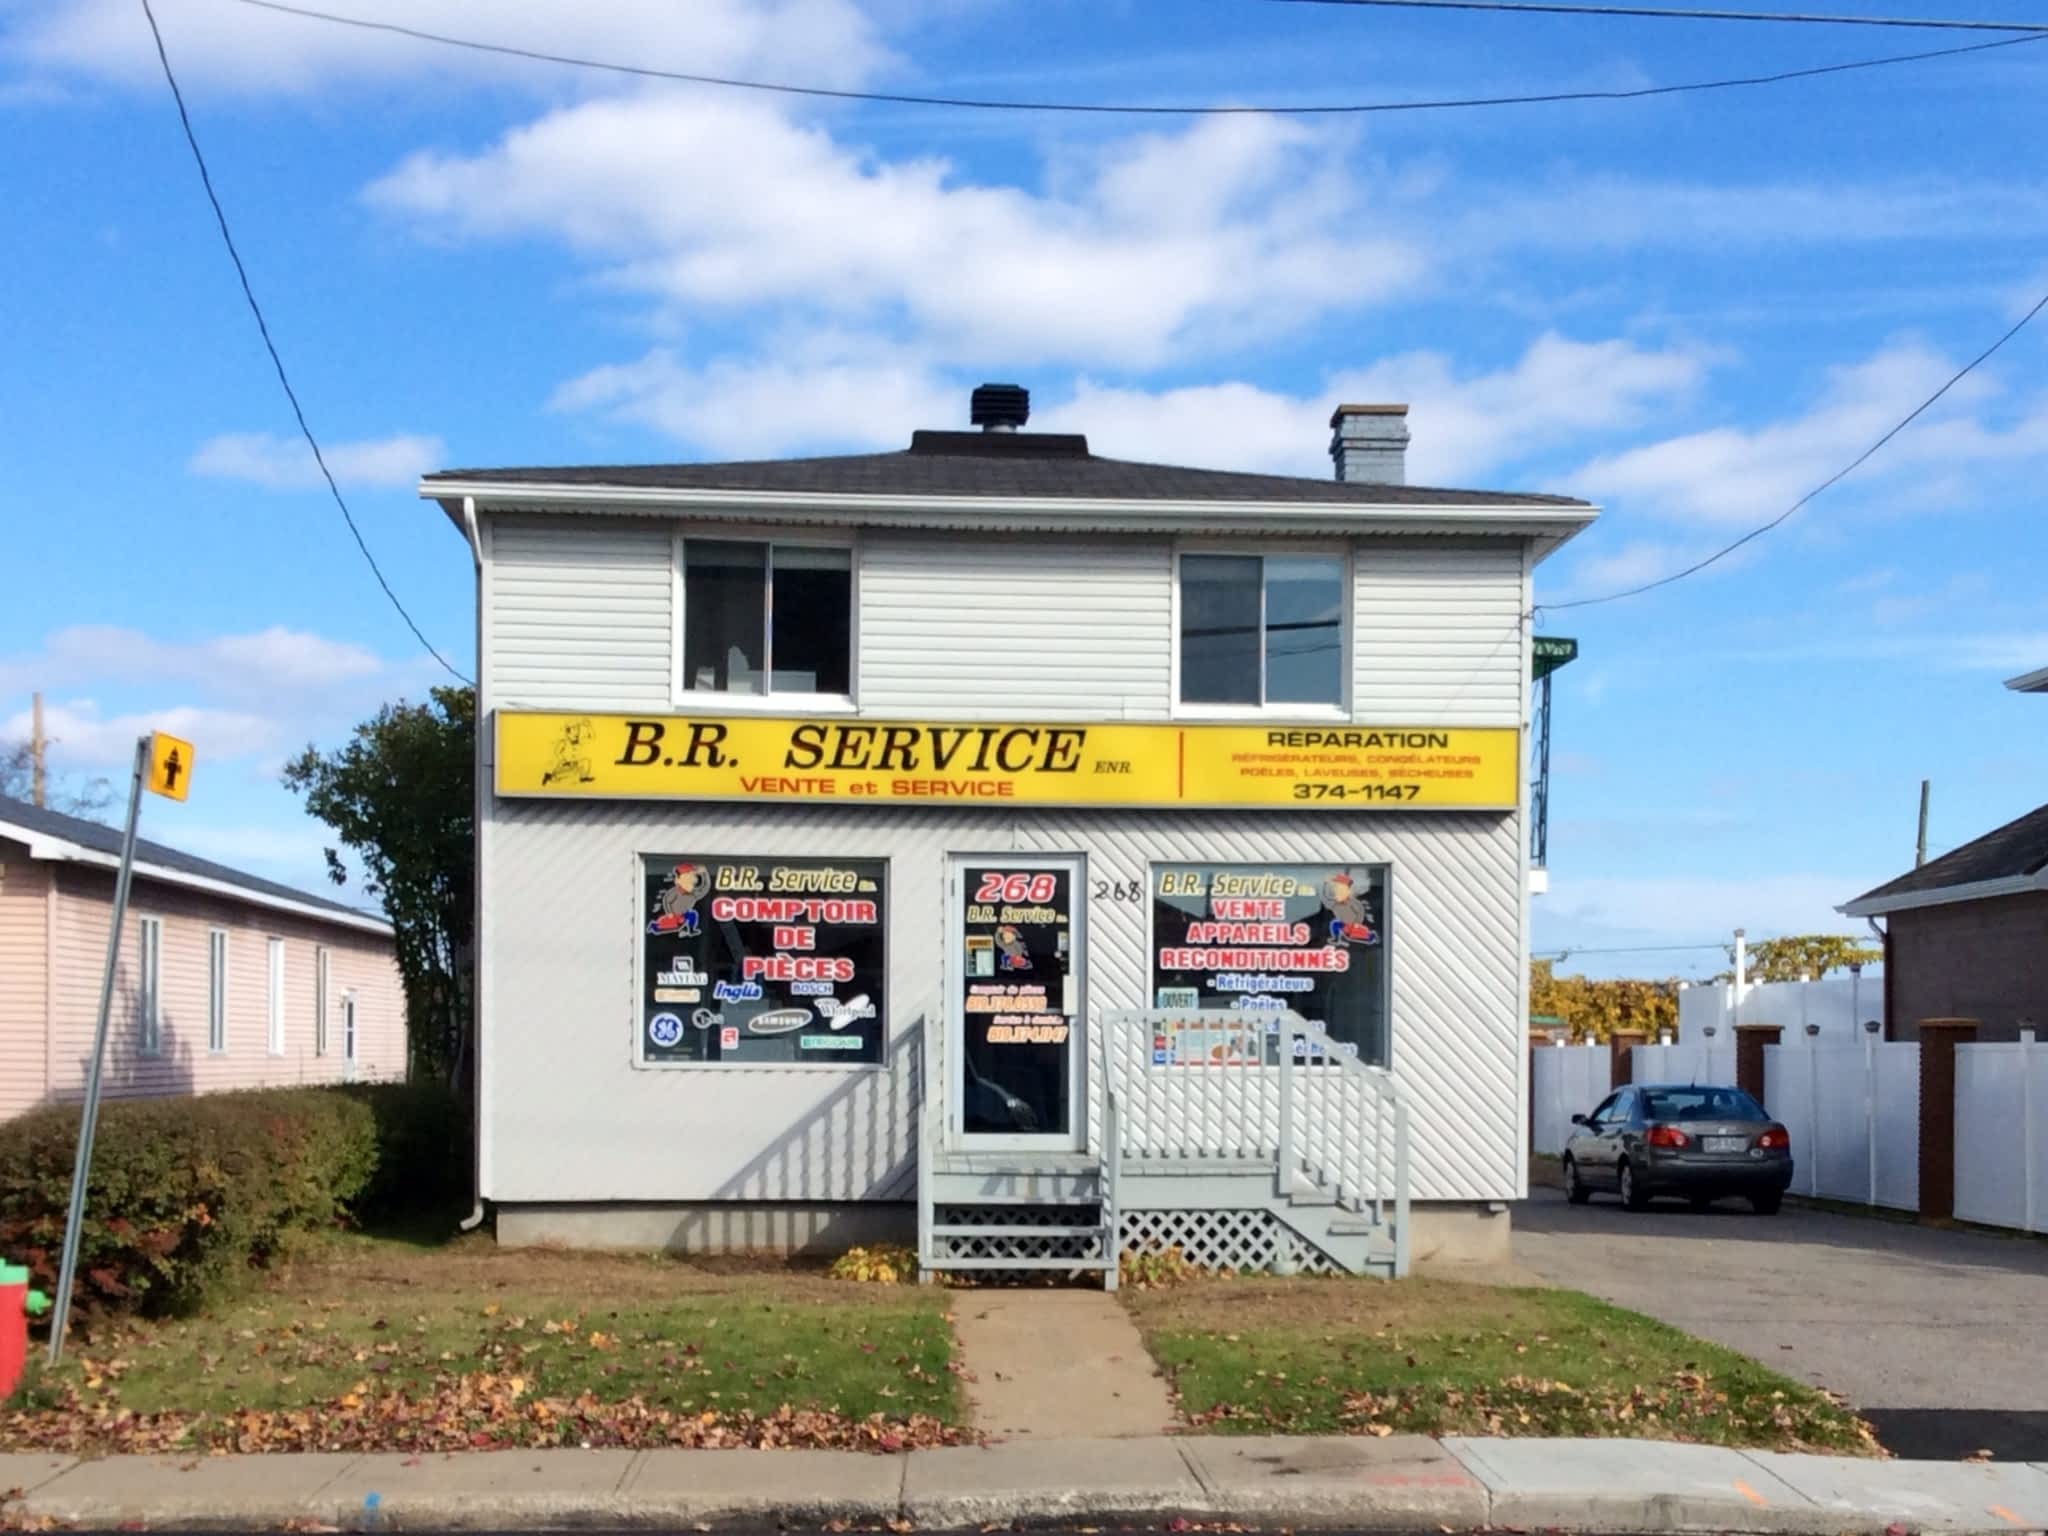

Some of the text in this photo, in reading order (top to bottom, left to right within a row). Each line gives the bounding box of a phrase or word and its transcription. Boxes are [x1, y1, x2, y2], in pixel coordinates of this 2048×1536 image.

[615, 721, 739, 768] B.R.
[784, 724, 1086, 773] SERVICE
[739, 777, 1014, 797] VENTE et SERVICE
[1293, 783, 1421, 801] 374-1147
[716, 866, 763, 891] B.R.
[770, 867, 857, 892] Service
[975, 872, 1056, 903] 268
[1160, 873, 1205, 896] B.R.
[1211, 873, 1297, 897] Service
[1095, 881, 1142, 902] 268
[712, 897, 877, 923] COMPTOIR
[1001, 905, 1056, 923] Service
[1211, 898, 1285, 920] VENTE
[774, 926, 815, 949] DE
[1186, 922, 1310, 944] APPAREILS
[743, 953, 855, 981] PIÈCES
[1160, 945, 1349, 971] RECONDITIONNÉS
[713, 980, 763, 1003] Inglis
[791, 983, 834, 995] BOSCH
[1215, 974, 1314, 993] Réfrigérateurs
